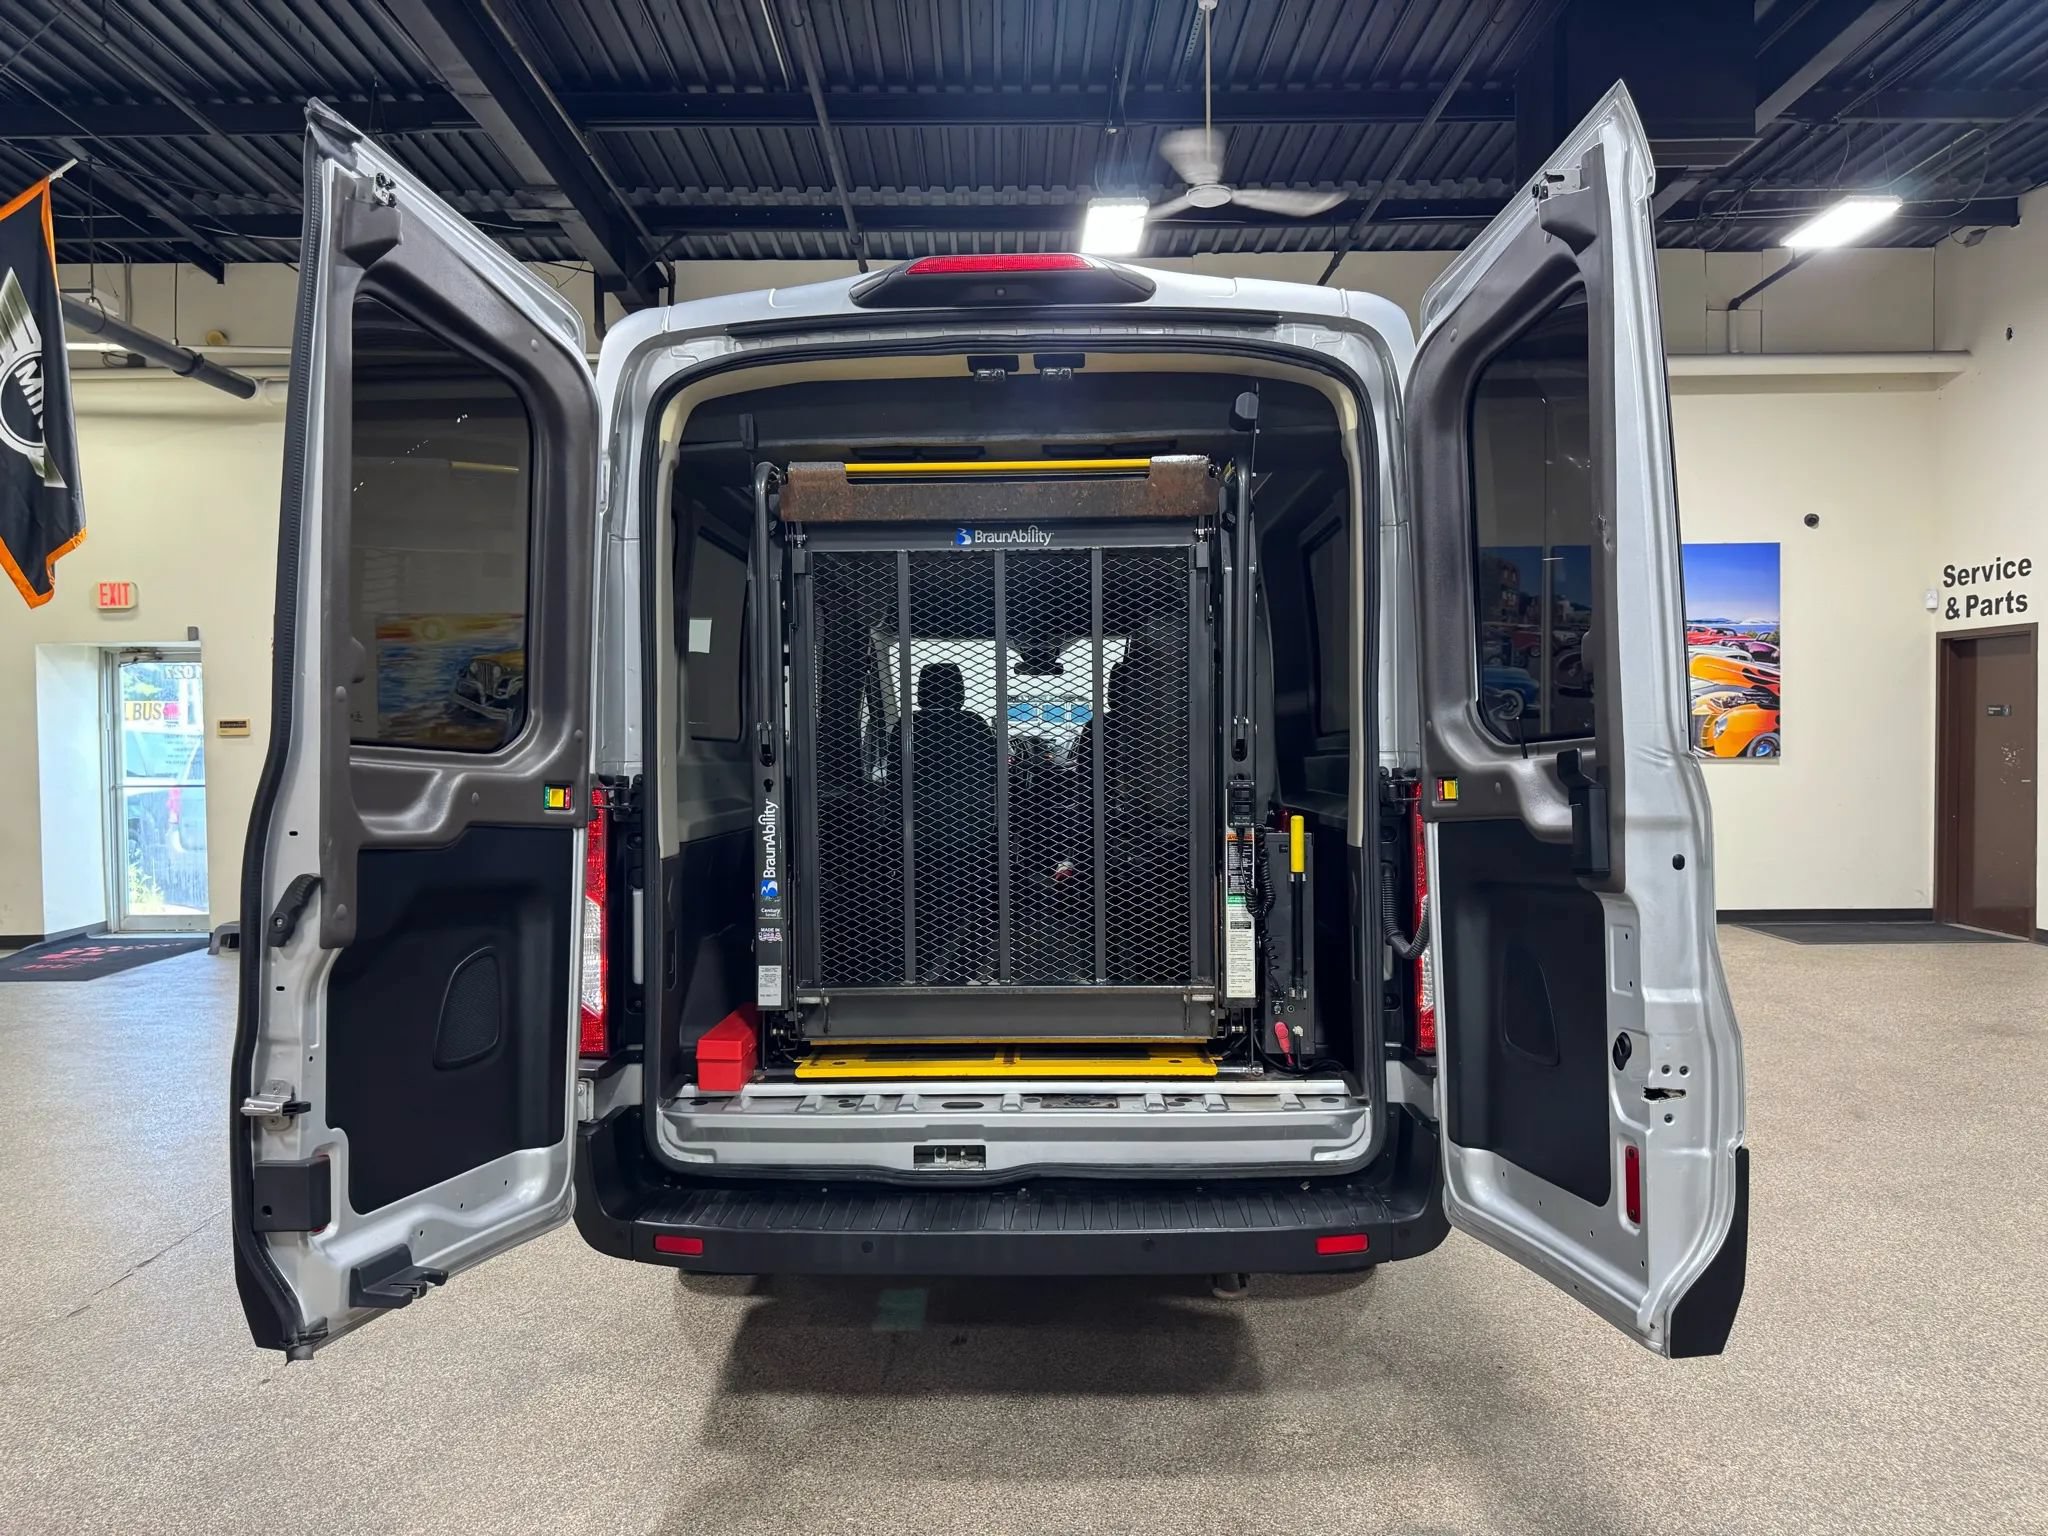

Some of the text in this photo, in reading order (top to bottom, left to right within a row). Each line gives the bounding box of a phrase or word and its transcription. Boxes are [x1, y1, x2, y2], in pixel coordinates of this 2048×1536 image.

[974, 525, 1054, 546] BraunAbility
[1943, 556, 2032, 588] Service
[99, 582, 130, 606] EXIT
[1945, 590, 2028, 620] & Parts
[133, 702, 162, 721] BUS
[758, 798, 779, 878] BraunAbility
